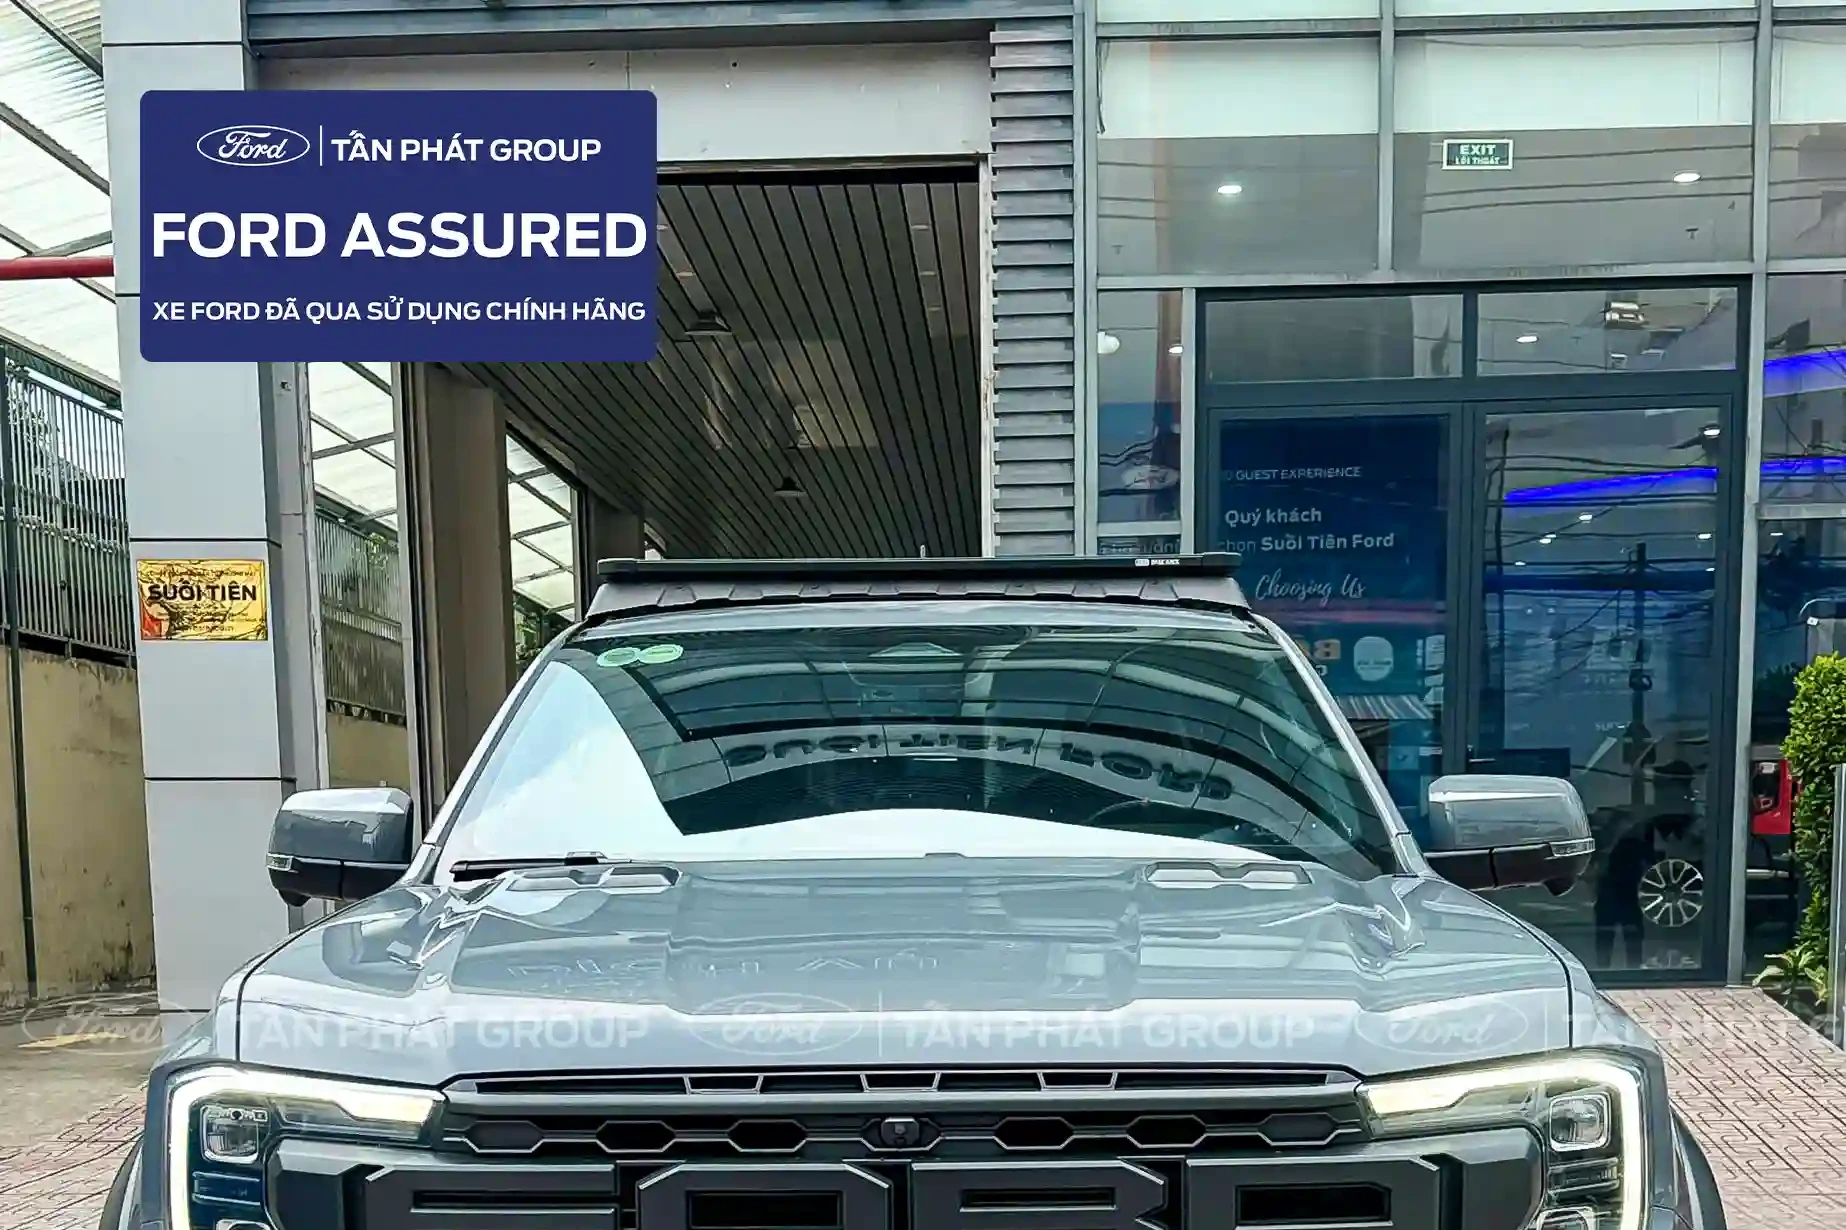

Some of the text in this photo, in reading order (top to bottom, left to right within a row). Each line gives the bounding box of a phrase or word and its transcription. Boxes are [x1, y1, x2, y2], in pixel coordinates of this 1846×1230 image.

[1460, 144, 1496, 155] EXIT
[1236, 470, 1278, 481] GUEST
[1281, 466, 1362, 480] EXPERIENCE
[1225, 508, 1322, 527] Quý khách
[1307, 534, 1347, 550] Tiên
[1352, 533, 1395, 548] Ford
[206, 580, 257, 601] TIÊN
[1255, 567, 1332, 608] Choosing
